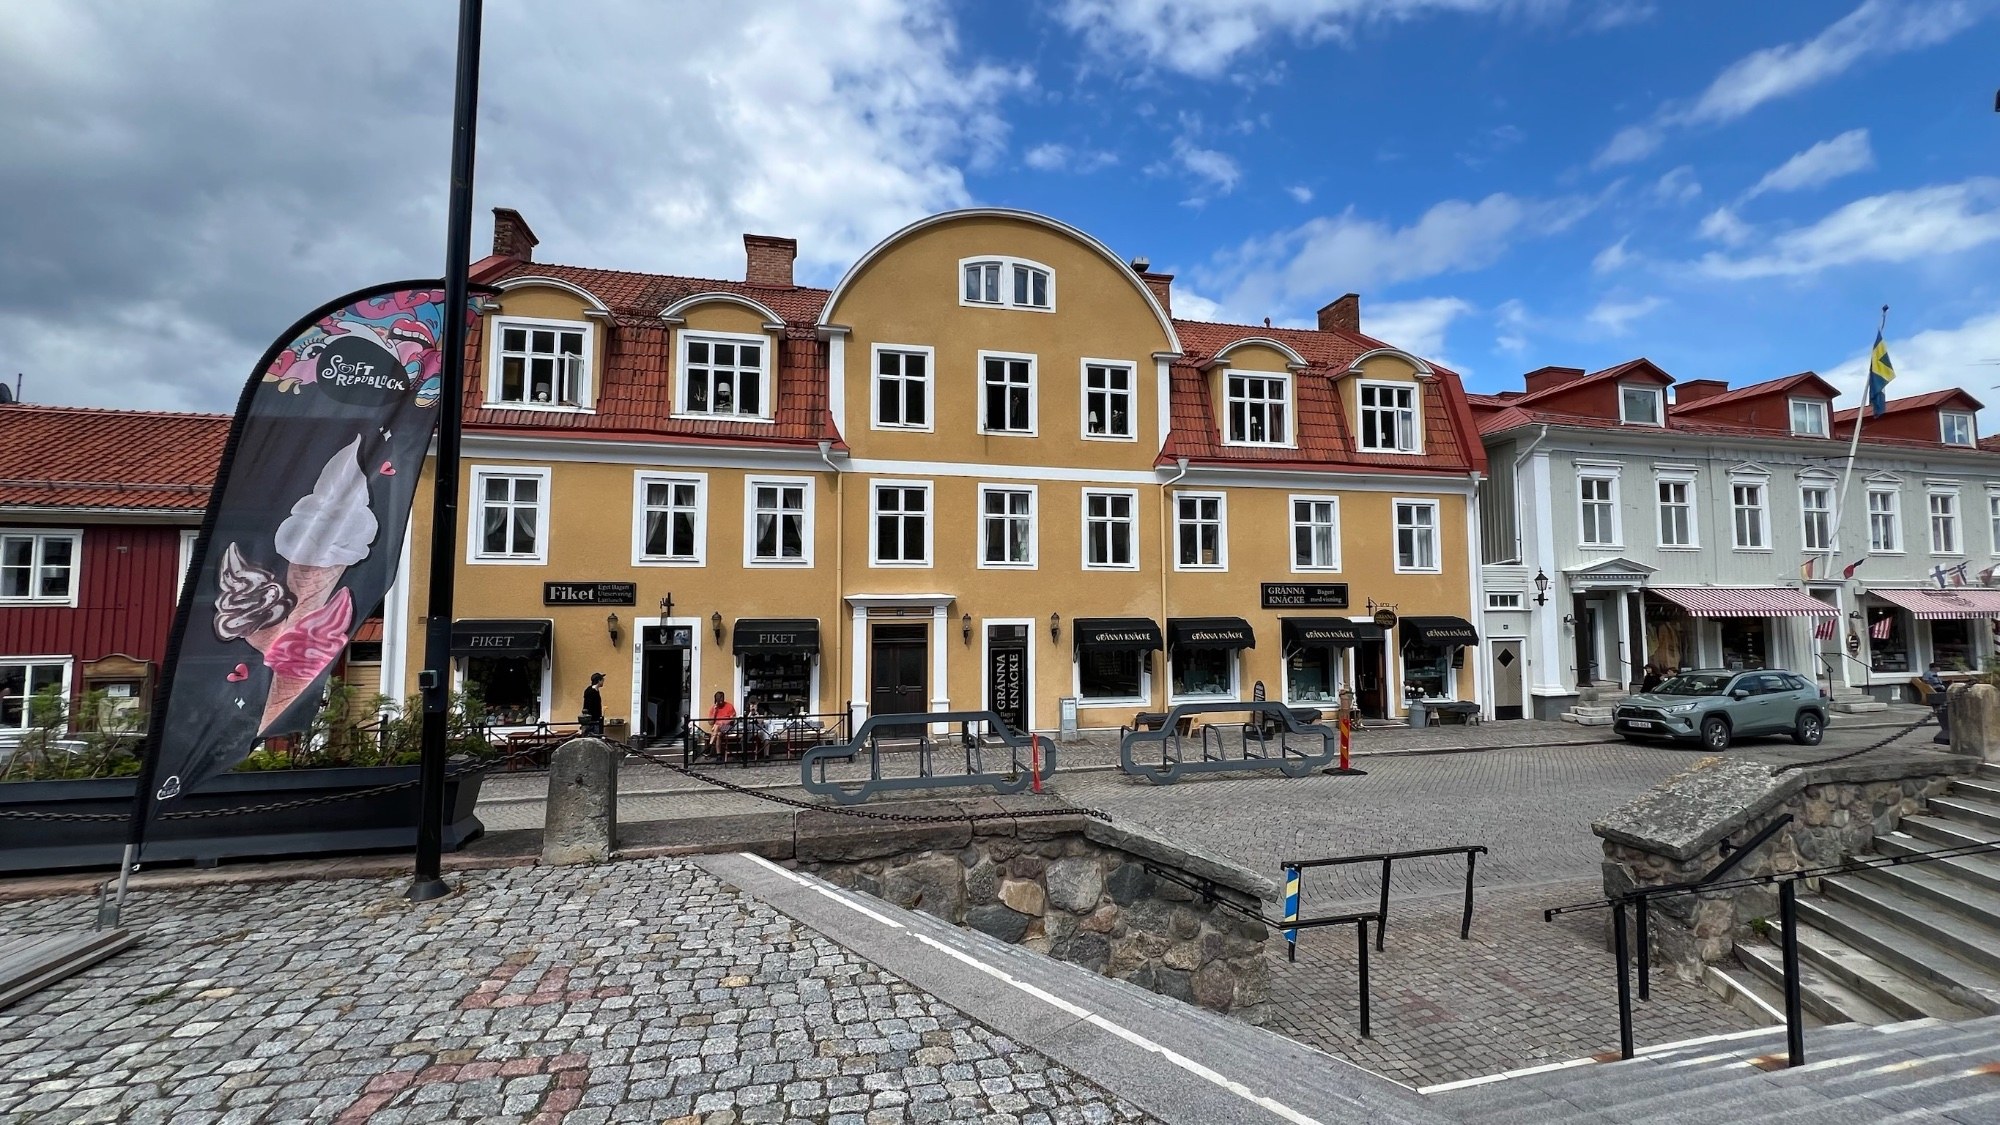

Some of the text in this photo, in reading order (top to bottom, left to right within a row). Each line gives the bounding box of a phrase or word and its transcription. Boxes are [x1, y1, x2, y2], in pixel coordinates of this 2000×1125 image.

[550, 586, 594, 600] Fiket
[1268, 586, 1305, 595] GRÄNNA
[1317, 588, 1335, 596] Bageri
[1269, 595, 1305, 604] KNÄCKE
[470, 636, 514, 646] FIKET
[760, 634, 796, 643] FIKET
[995, 653, 1006, 710] GRÄNNA
[1008, 653, 1019, 709] KNÄCKE
